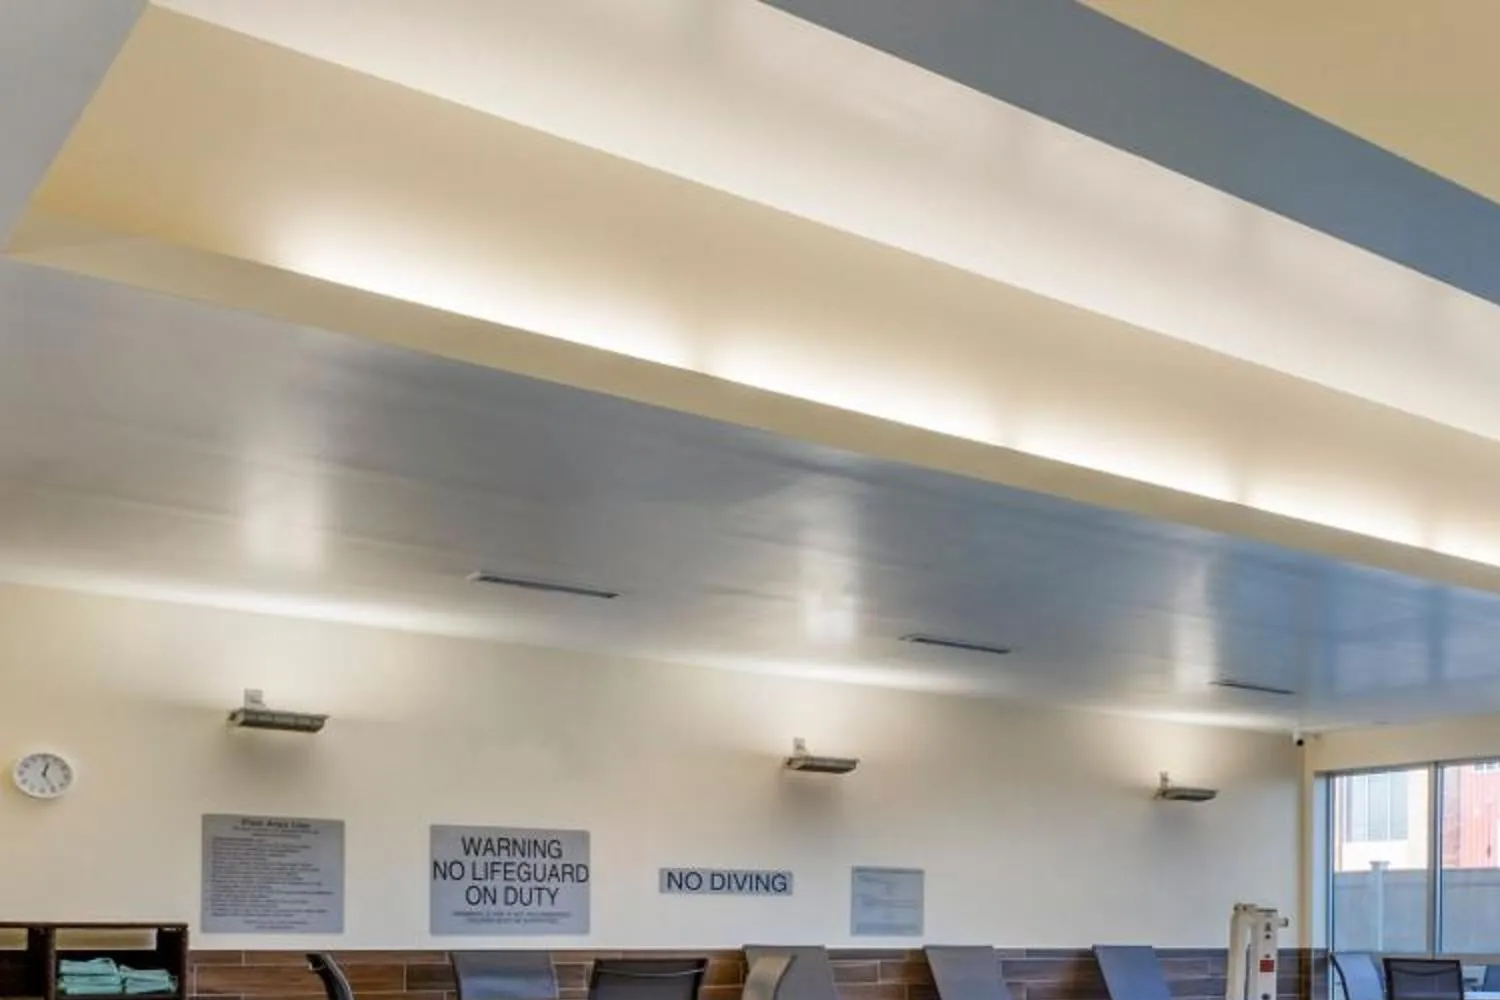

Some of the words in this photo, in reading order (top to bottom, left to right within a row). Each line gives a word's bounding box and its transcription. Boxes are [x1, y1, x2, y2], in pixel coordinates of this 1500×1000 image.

[461, 836, 563, 859] WARNING
[433, 860, 465, 881] NO
[471, 861, 590, 883] LIFEGUARD
[666, 870, 703, 891] NO
[710, 872, 788, 893] DIVING
[465, 885, 497, 906] ON
[503, 885, 560, 907] DUTY
